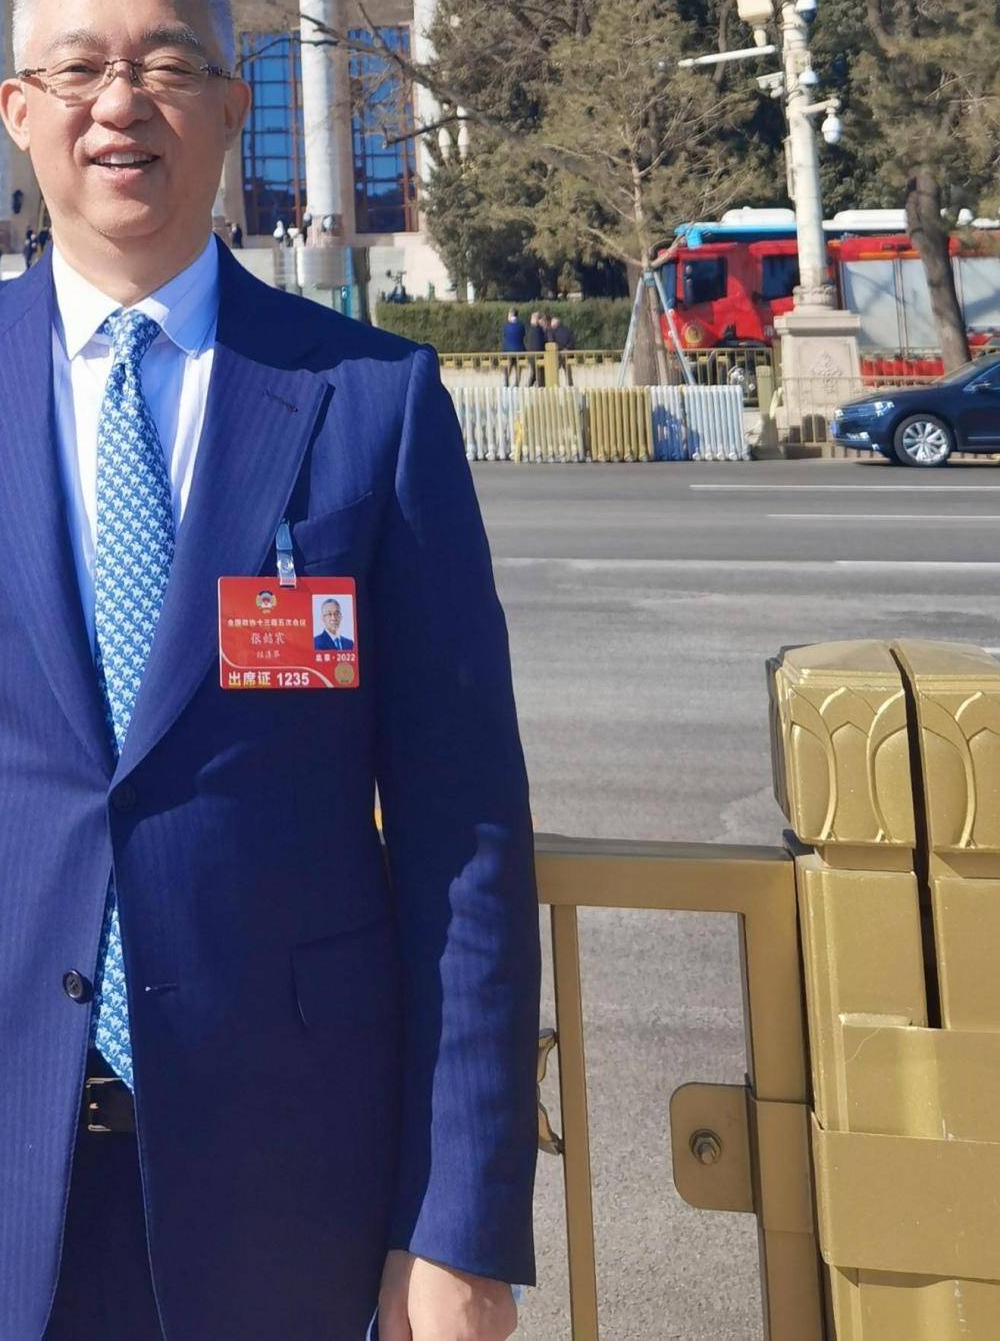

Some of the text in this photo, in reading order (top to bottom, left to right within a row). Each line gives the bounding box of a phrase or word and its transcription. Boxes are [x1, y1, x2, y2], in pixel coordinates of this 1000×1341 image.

[228, 671, 310, 687] 出席证 1235
